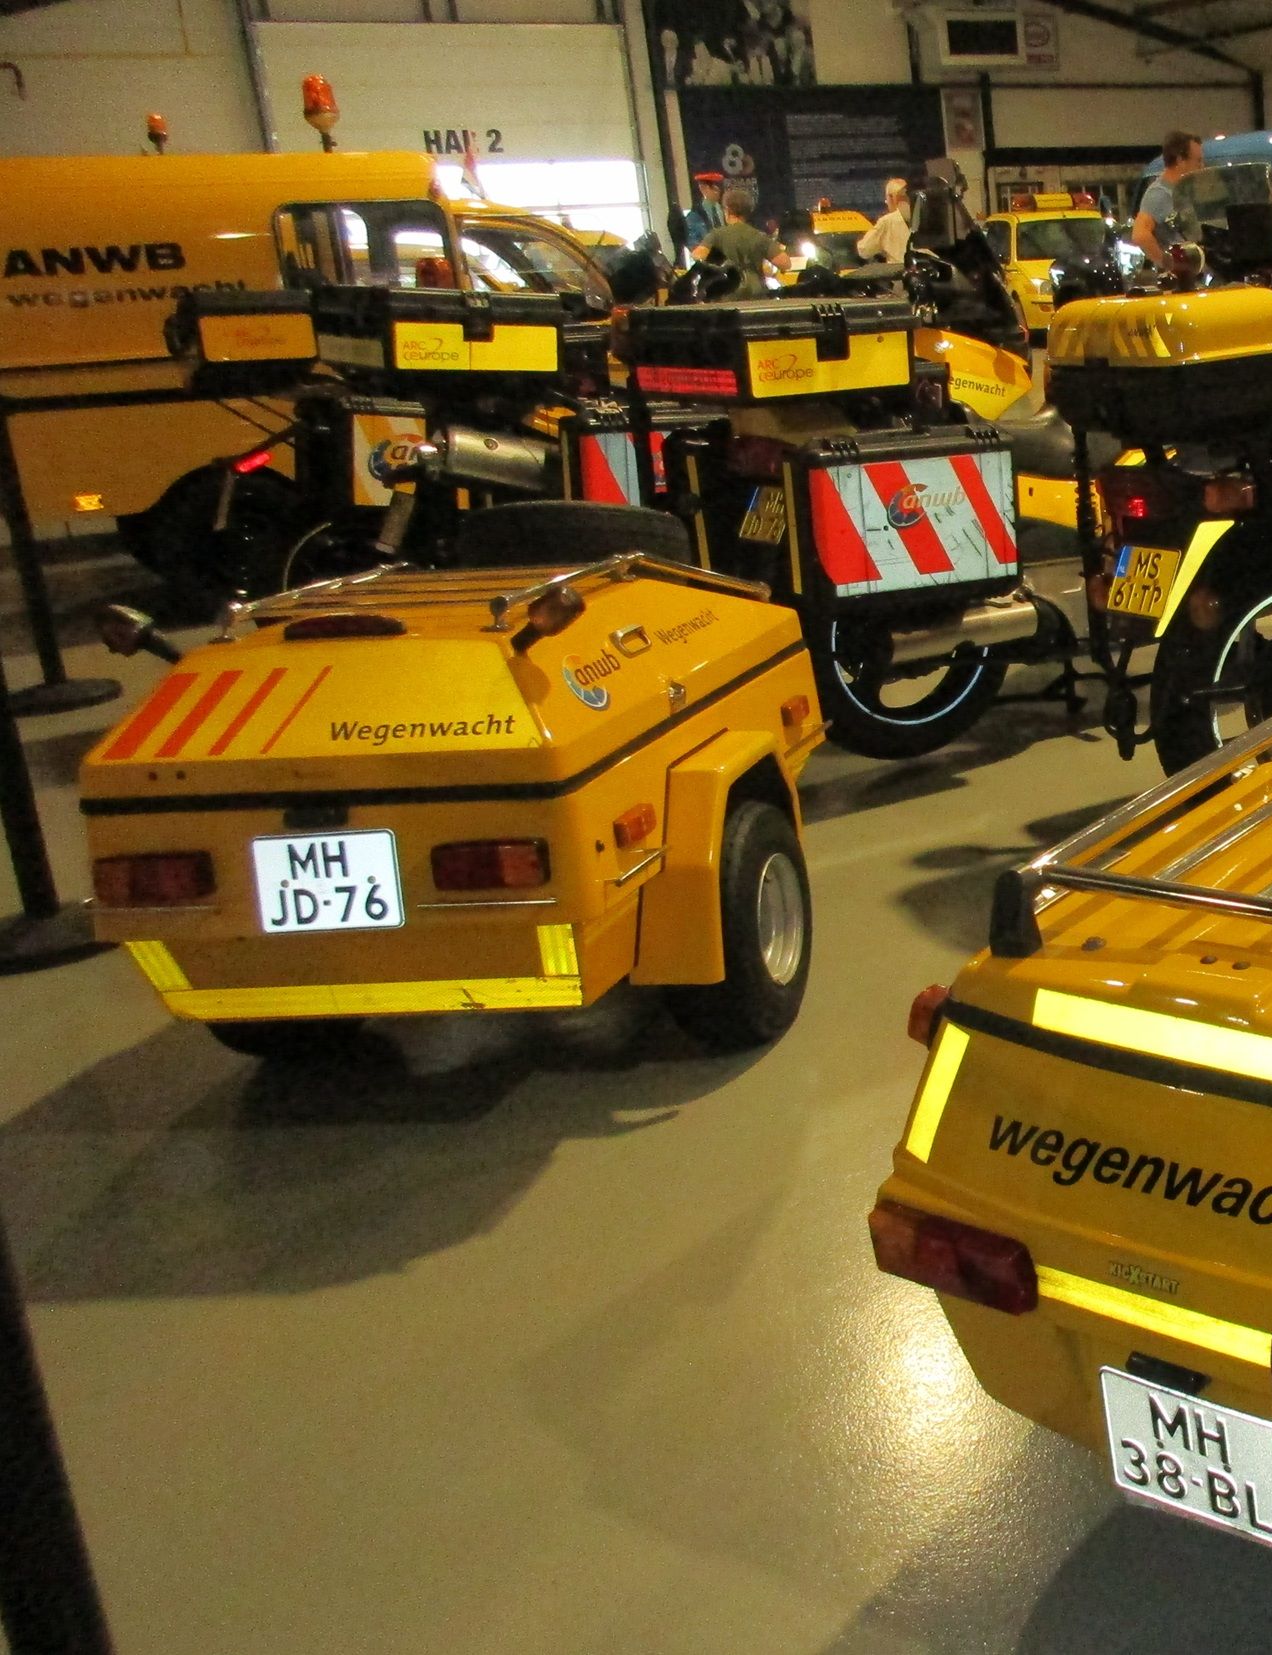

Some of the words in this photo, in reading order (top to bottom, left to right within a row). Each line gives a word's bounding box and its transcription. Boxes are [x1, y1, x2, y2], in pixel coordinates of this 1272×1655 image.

[486, 128, 504, 153] 2
[4, 243, 186, 277] ANWB
[949, 376, 1007, 398] egenwacht
[1136, 552, 1163, 580] MS
[331, 714, 516, 747] Wegenwacht
[287, 840, 349, 880] MH
[271, 884, 389, 926] JD-76
[1149, 1392, 1231, 1466] MH
